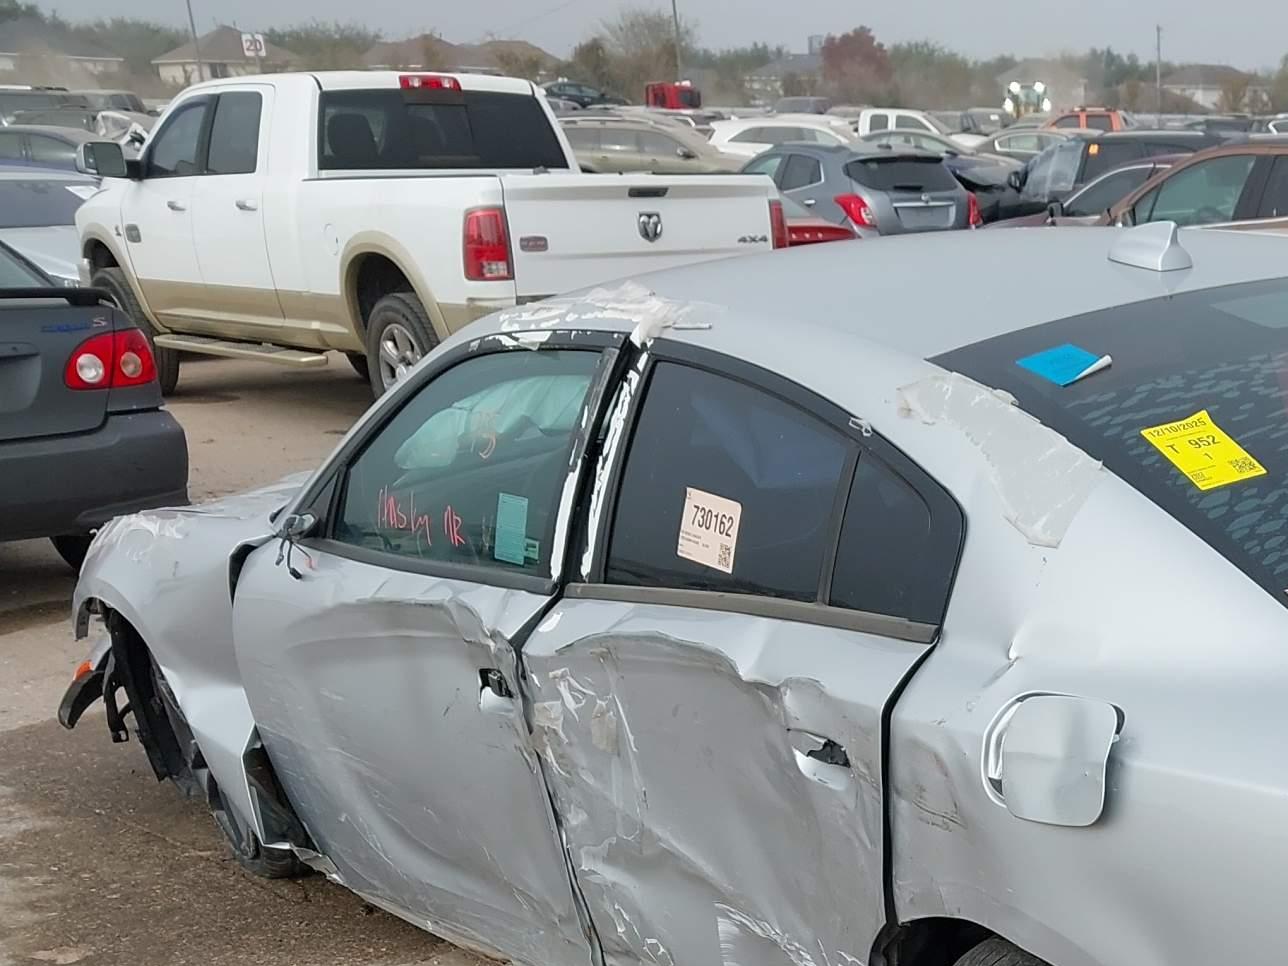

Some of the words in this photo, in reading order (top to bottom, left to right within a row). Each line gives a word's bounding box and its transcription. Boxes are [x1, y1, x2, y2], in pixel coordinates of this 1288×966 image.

[244, 38, 263, 52] 20
[1147, 416, 1208, 438] 12/10/2025
[1166, 443, 1181, 455] T
[1188, 433, 1222, 450] 952
[690, 503, 735, 539] 730162
